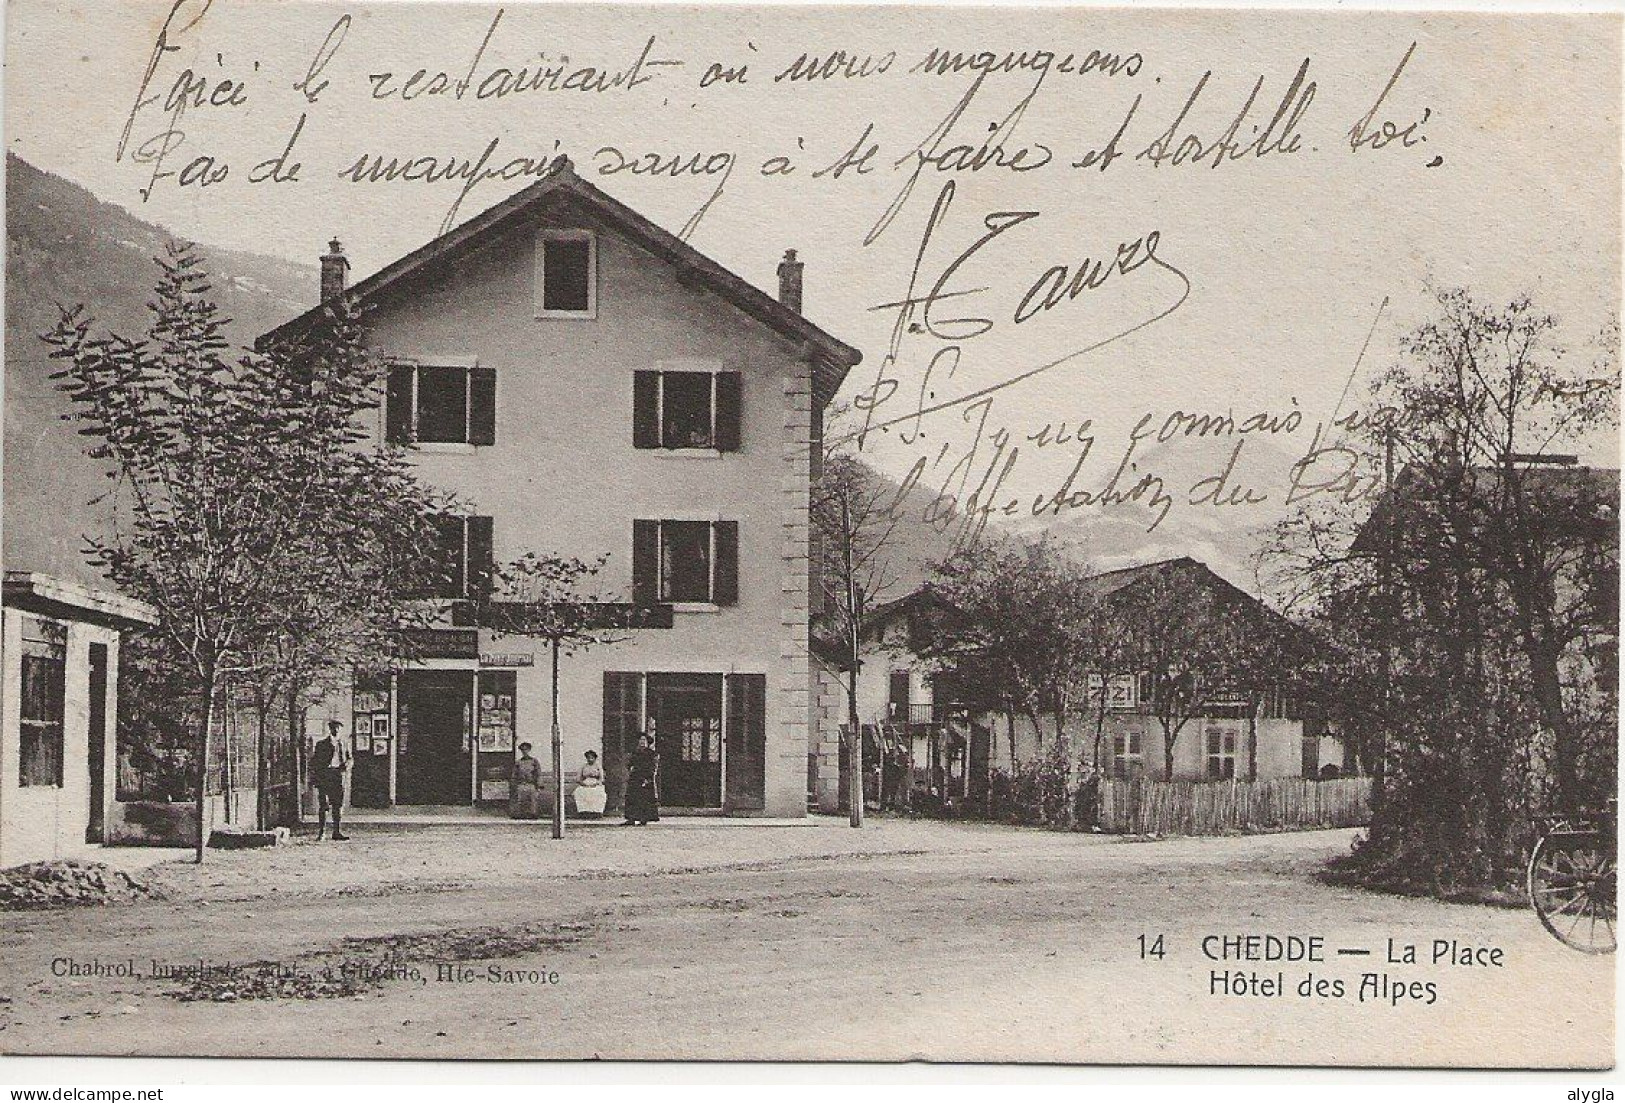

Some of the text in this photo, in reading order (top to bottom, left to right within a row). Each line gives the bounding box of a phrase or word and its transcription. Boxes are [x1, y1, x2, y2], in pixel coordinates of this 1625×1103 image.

[775, 50, 896, 84] nous
[249, 113, 304, 182] de
[762, 136, 805, 176] à
[1137, 934, 1166, 960] 14
[1202, 935, 1324, 962] CHEDDE
[1387, 938, 1416, 965] La
[1432, 940, 1504, 968] Place
[436, 963, 559, 985] Hte-Savoie
[1210, 970, 1437, 1006] Hôtel des Alpes
